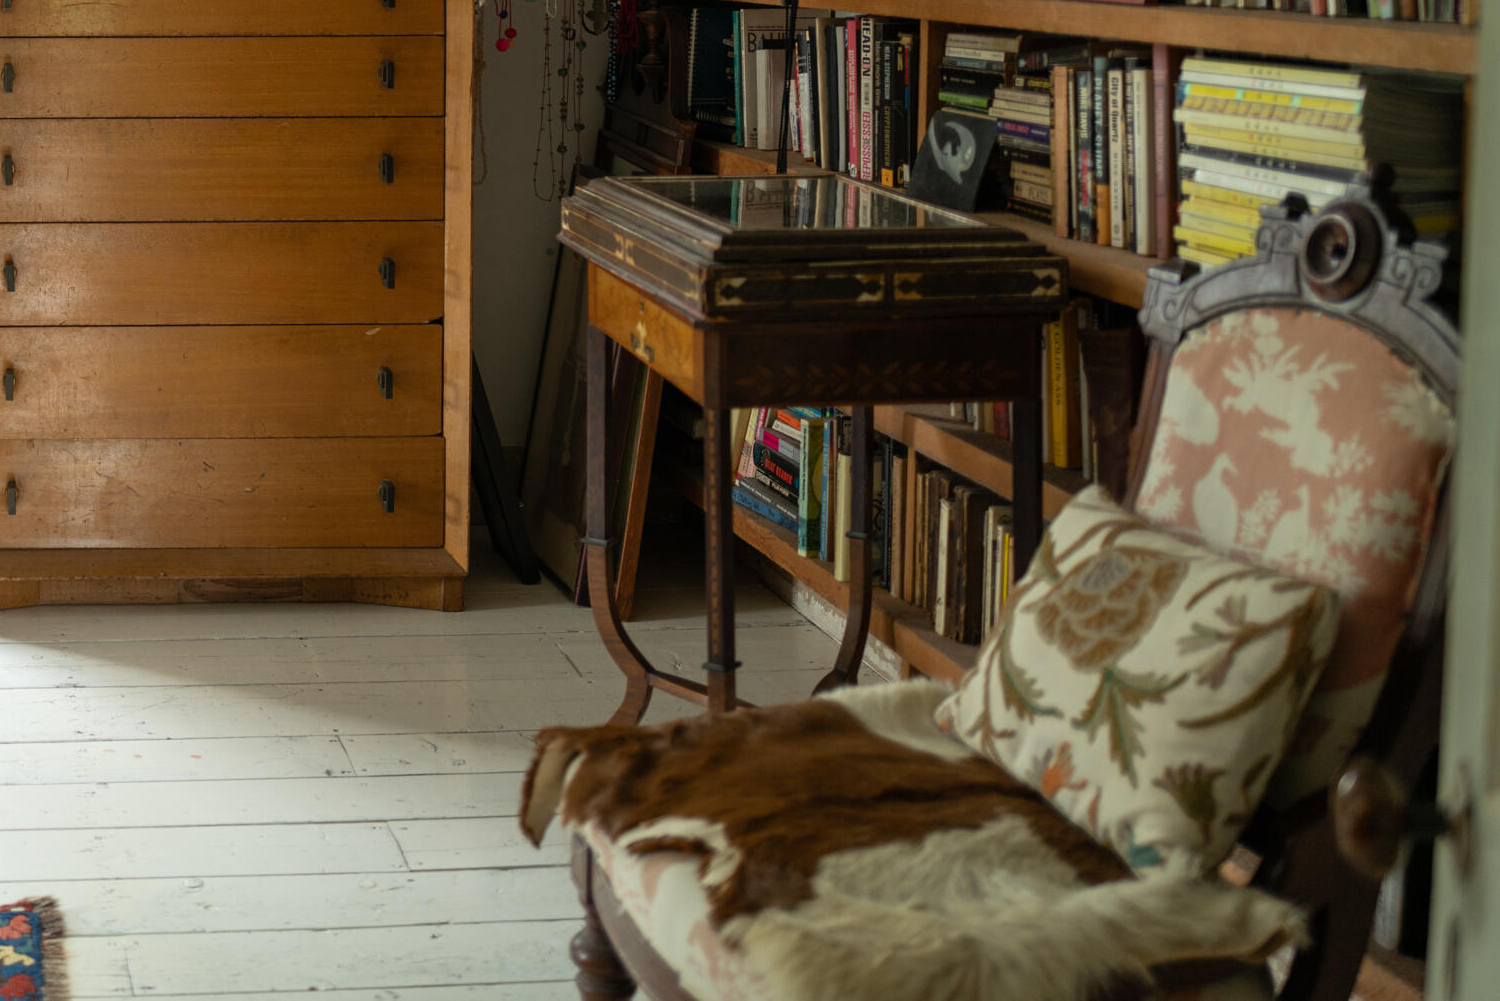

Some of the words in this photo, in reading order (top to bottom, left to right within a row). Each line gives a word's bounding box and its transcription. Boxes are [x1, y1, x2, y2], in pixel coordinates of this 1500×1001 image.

[883, 61, 891, 100] STEPHENSON
[1110, 76, 1120, 97] City
[1094, 76, 1103, 127] PLANET
[883, 104, 892, 167] CRYPTONOMICON
[1080, 111, 1089, 139] DAVIS
[1110, 110, 1120, 143] Quartz
